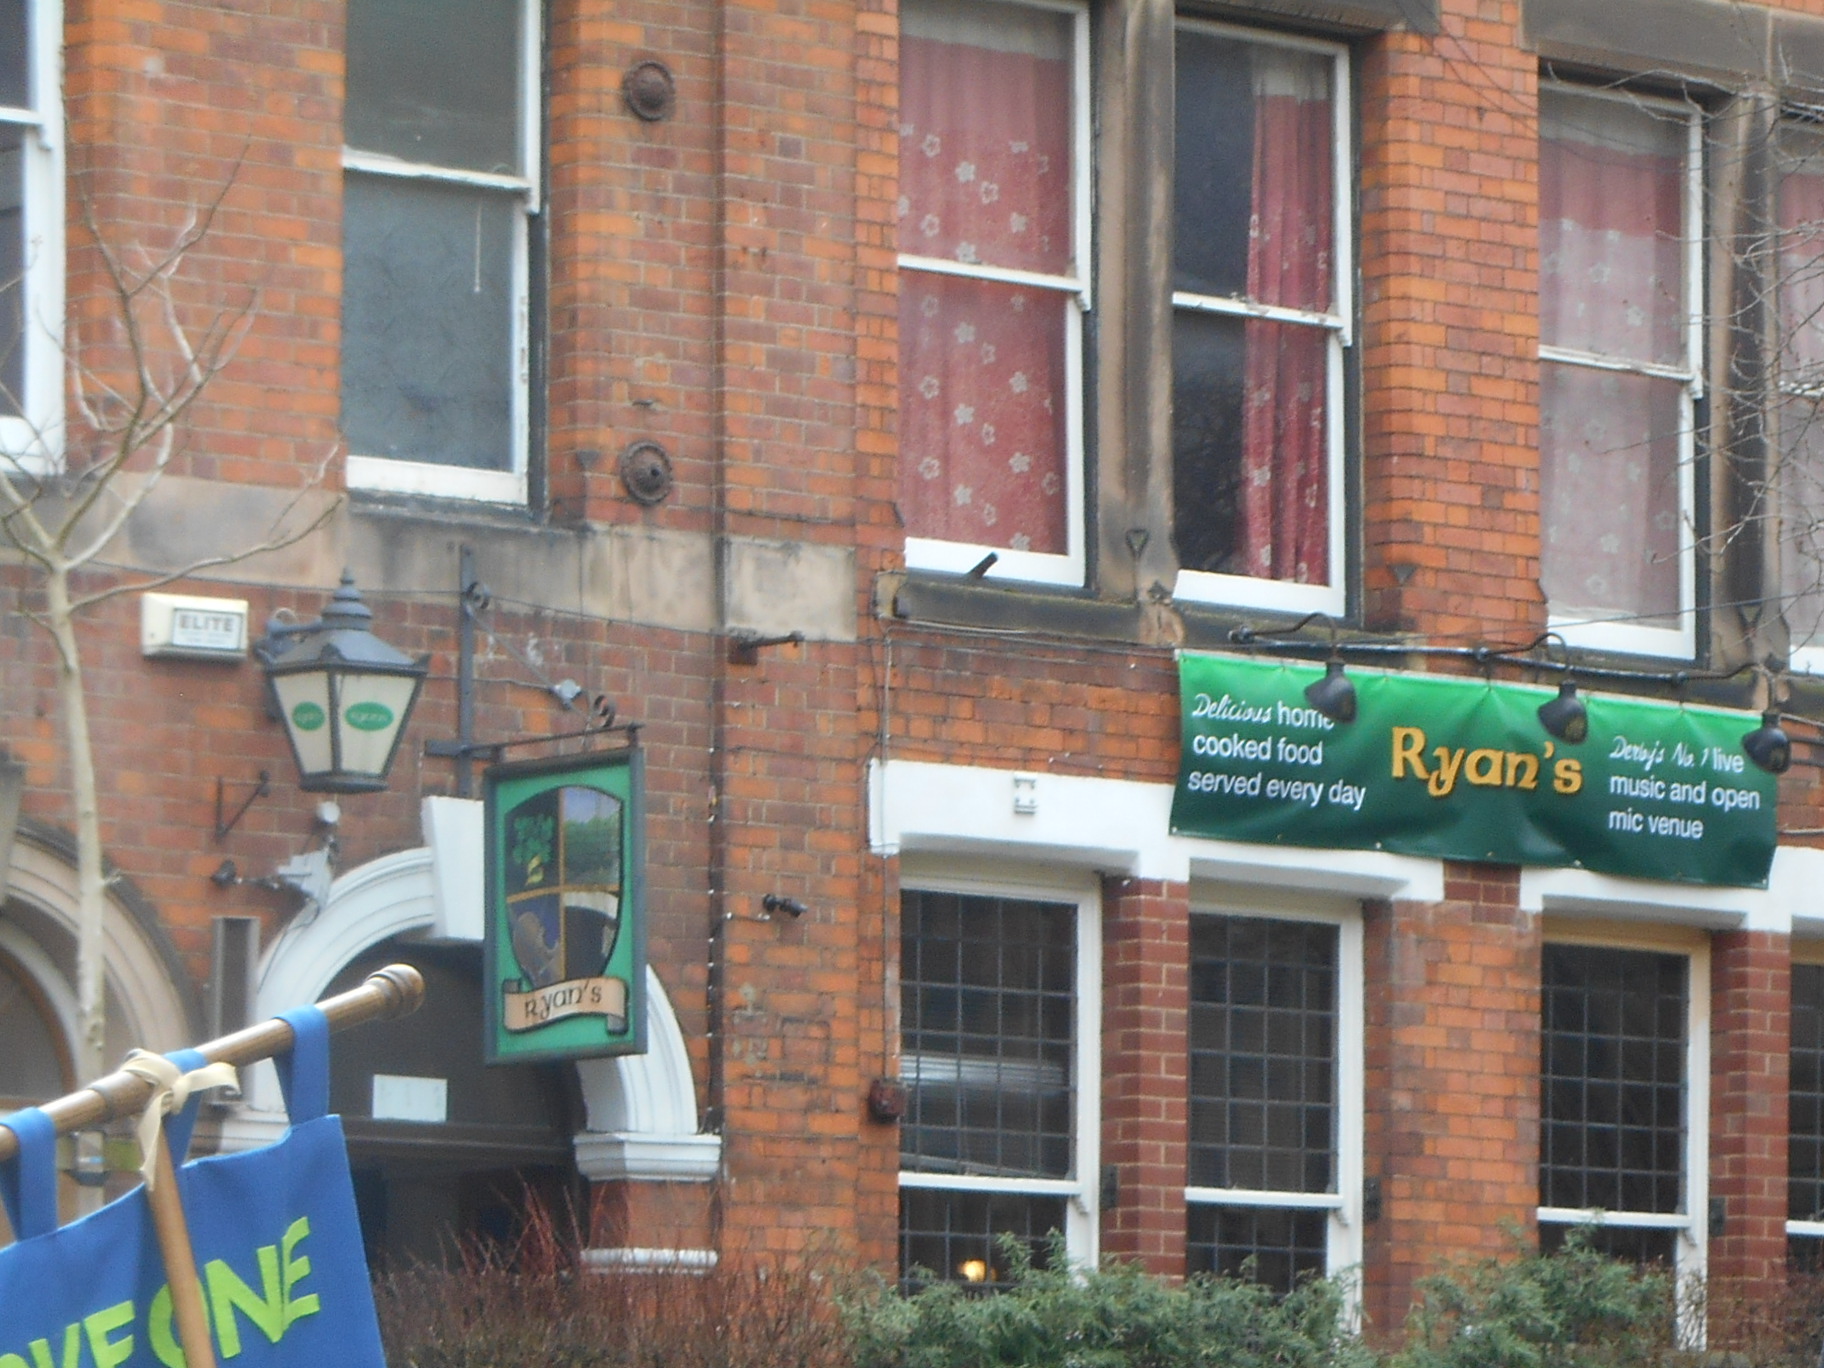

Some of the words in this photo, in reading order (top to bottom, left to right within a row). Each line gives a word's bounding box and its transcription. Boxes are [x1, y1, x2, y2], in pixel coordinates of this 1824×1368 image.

[179, 613, 234, 632] ELITE
[1191, 693, 1273, 723] Delicious
[1193, 732, 1273, 761] cooked
[1277, 737, 1323, 765] food
[1391, 725, 1584, 797] Ryan's
[1609, 735, 1666, 771] Derby's
[1670, 742, 1695, 767] No.
[1700, 747, 1710, 767] 1
[1712, 746, 1744, 773] live
[1186, 771, 1263, 796] served
[1265, 778, 1325, 808] every
[1328, 779, 1367, 811] day
[1609, 774, 1666, 799] music
[1669, 780, 1707, 804] and
[1711, 786, 1761, 813] open
[1608, 807, 1644, 832] mic
[1648, 814, 1704, 839] venue
[524, 979, 602, 1020] Ryan's
